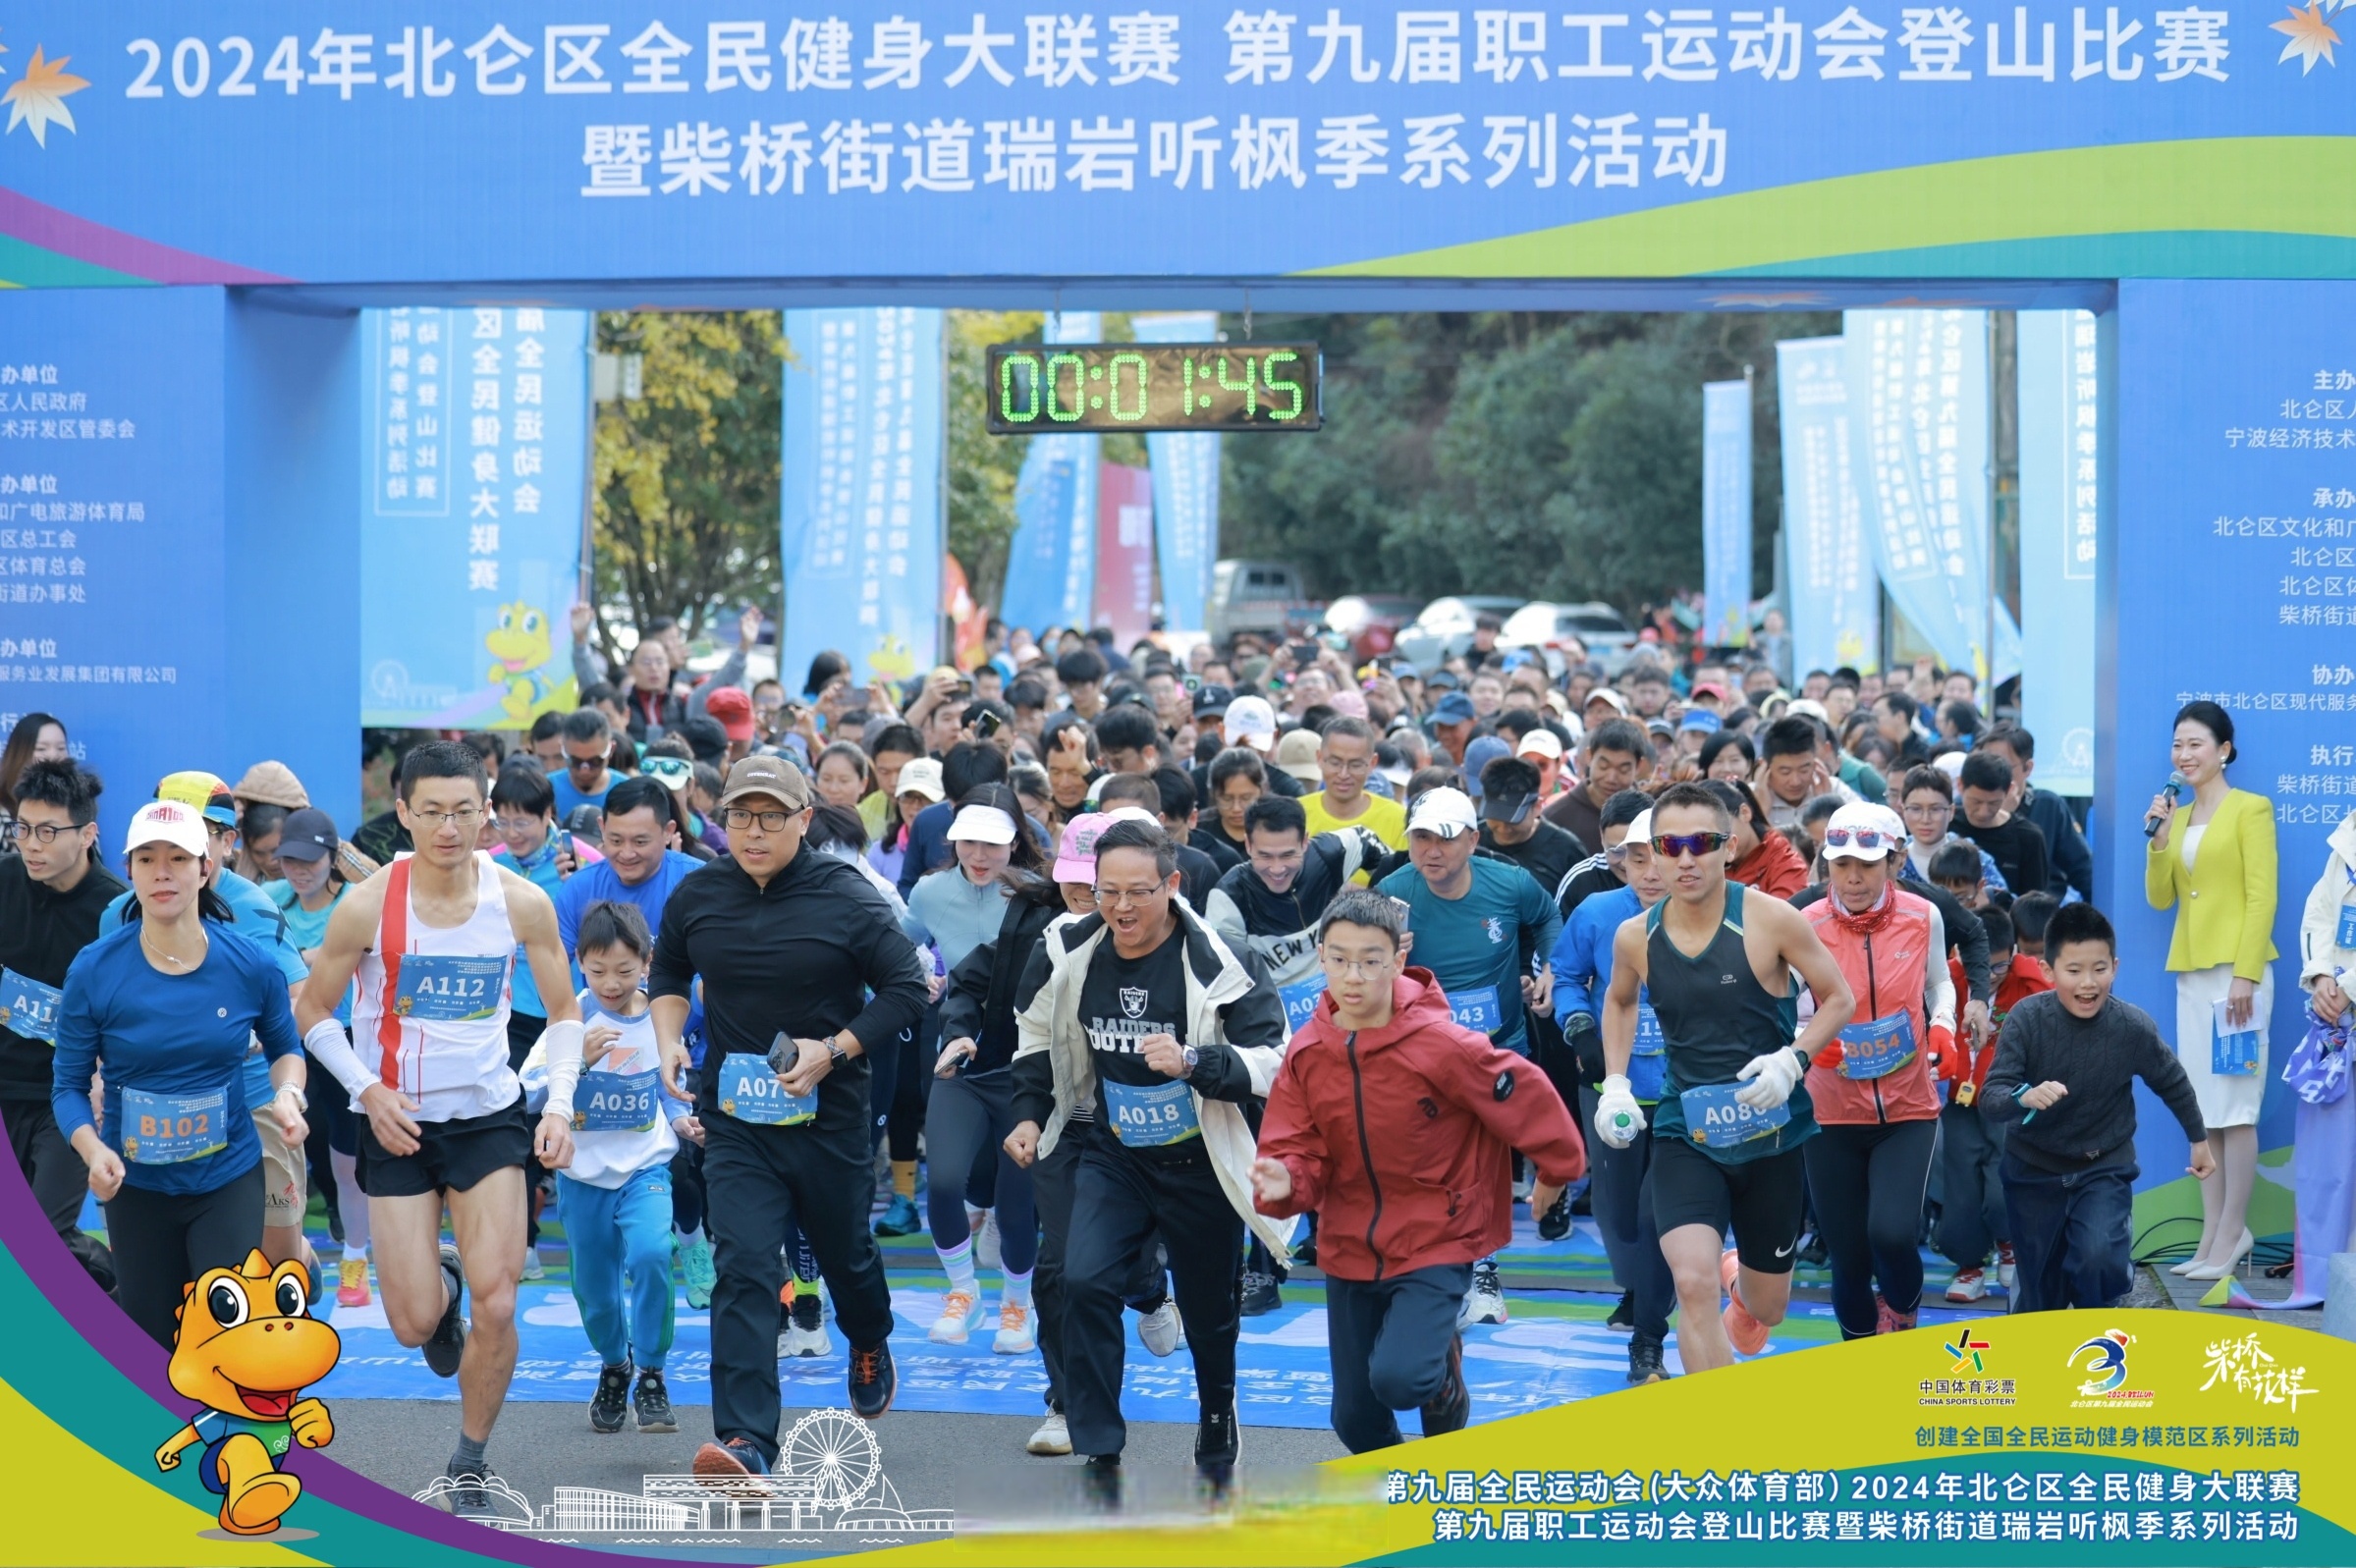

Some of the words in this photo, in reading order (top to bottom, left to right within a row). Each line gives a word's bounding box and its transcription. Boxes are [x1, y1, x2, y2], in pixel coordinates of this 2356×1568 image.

[125, 11, 1180, 99] 2024年北仑区全民健身大联赛
[1224, 6, 2230, 85] 第九届职工运动会登山比赛
[580, 112, 1727, 196] 暨柴桥街道瑞岩听枫季系列活动
[1001, 351, 1302, 422] 00:01:45
[2224, 427, 2356, 449] 宁波经济技术
[2290, 546, 2356, 568] 北仑区
[2312, 664, 2355, 685] 协办
[1261, 939, 1303, 971] NEW
[415, 976, 485, 998] A112
[13, 995, 58, 1023] A11
[1450, 1006, 1485, 1024] 043
[1092, 1016, 1177, 1037] RAIDERS
[1845, 1033, 1900, 1058] B054
[737, 1076, 796, 1099] A07
[589, 1091, 649, 1111] A036
[139, 1113, 209, 1139] B102
[1118, 1103, 1179, 1126] A018
